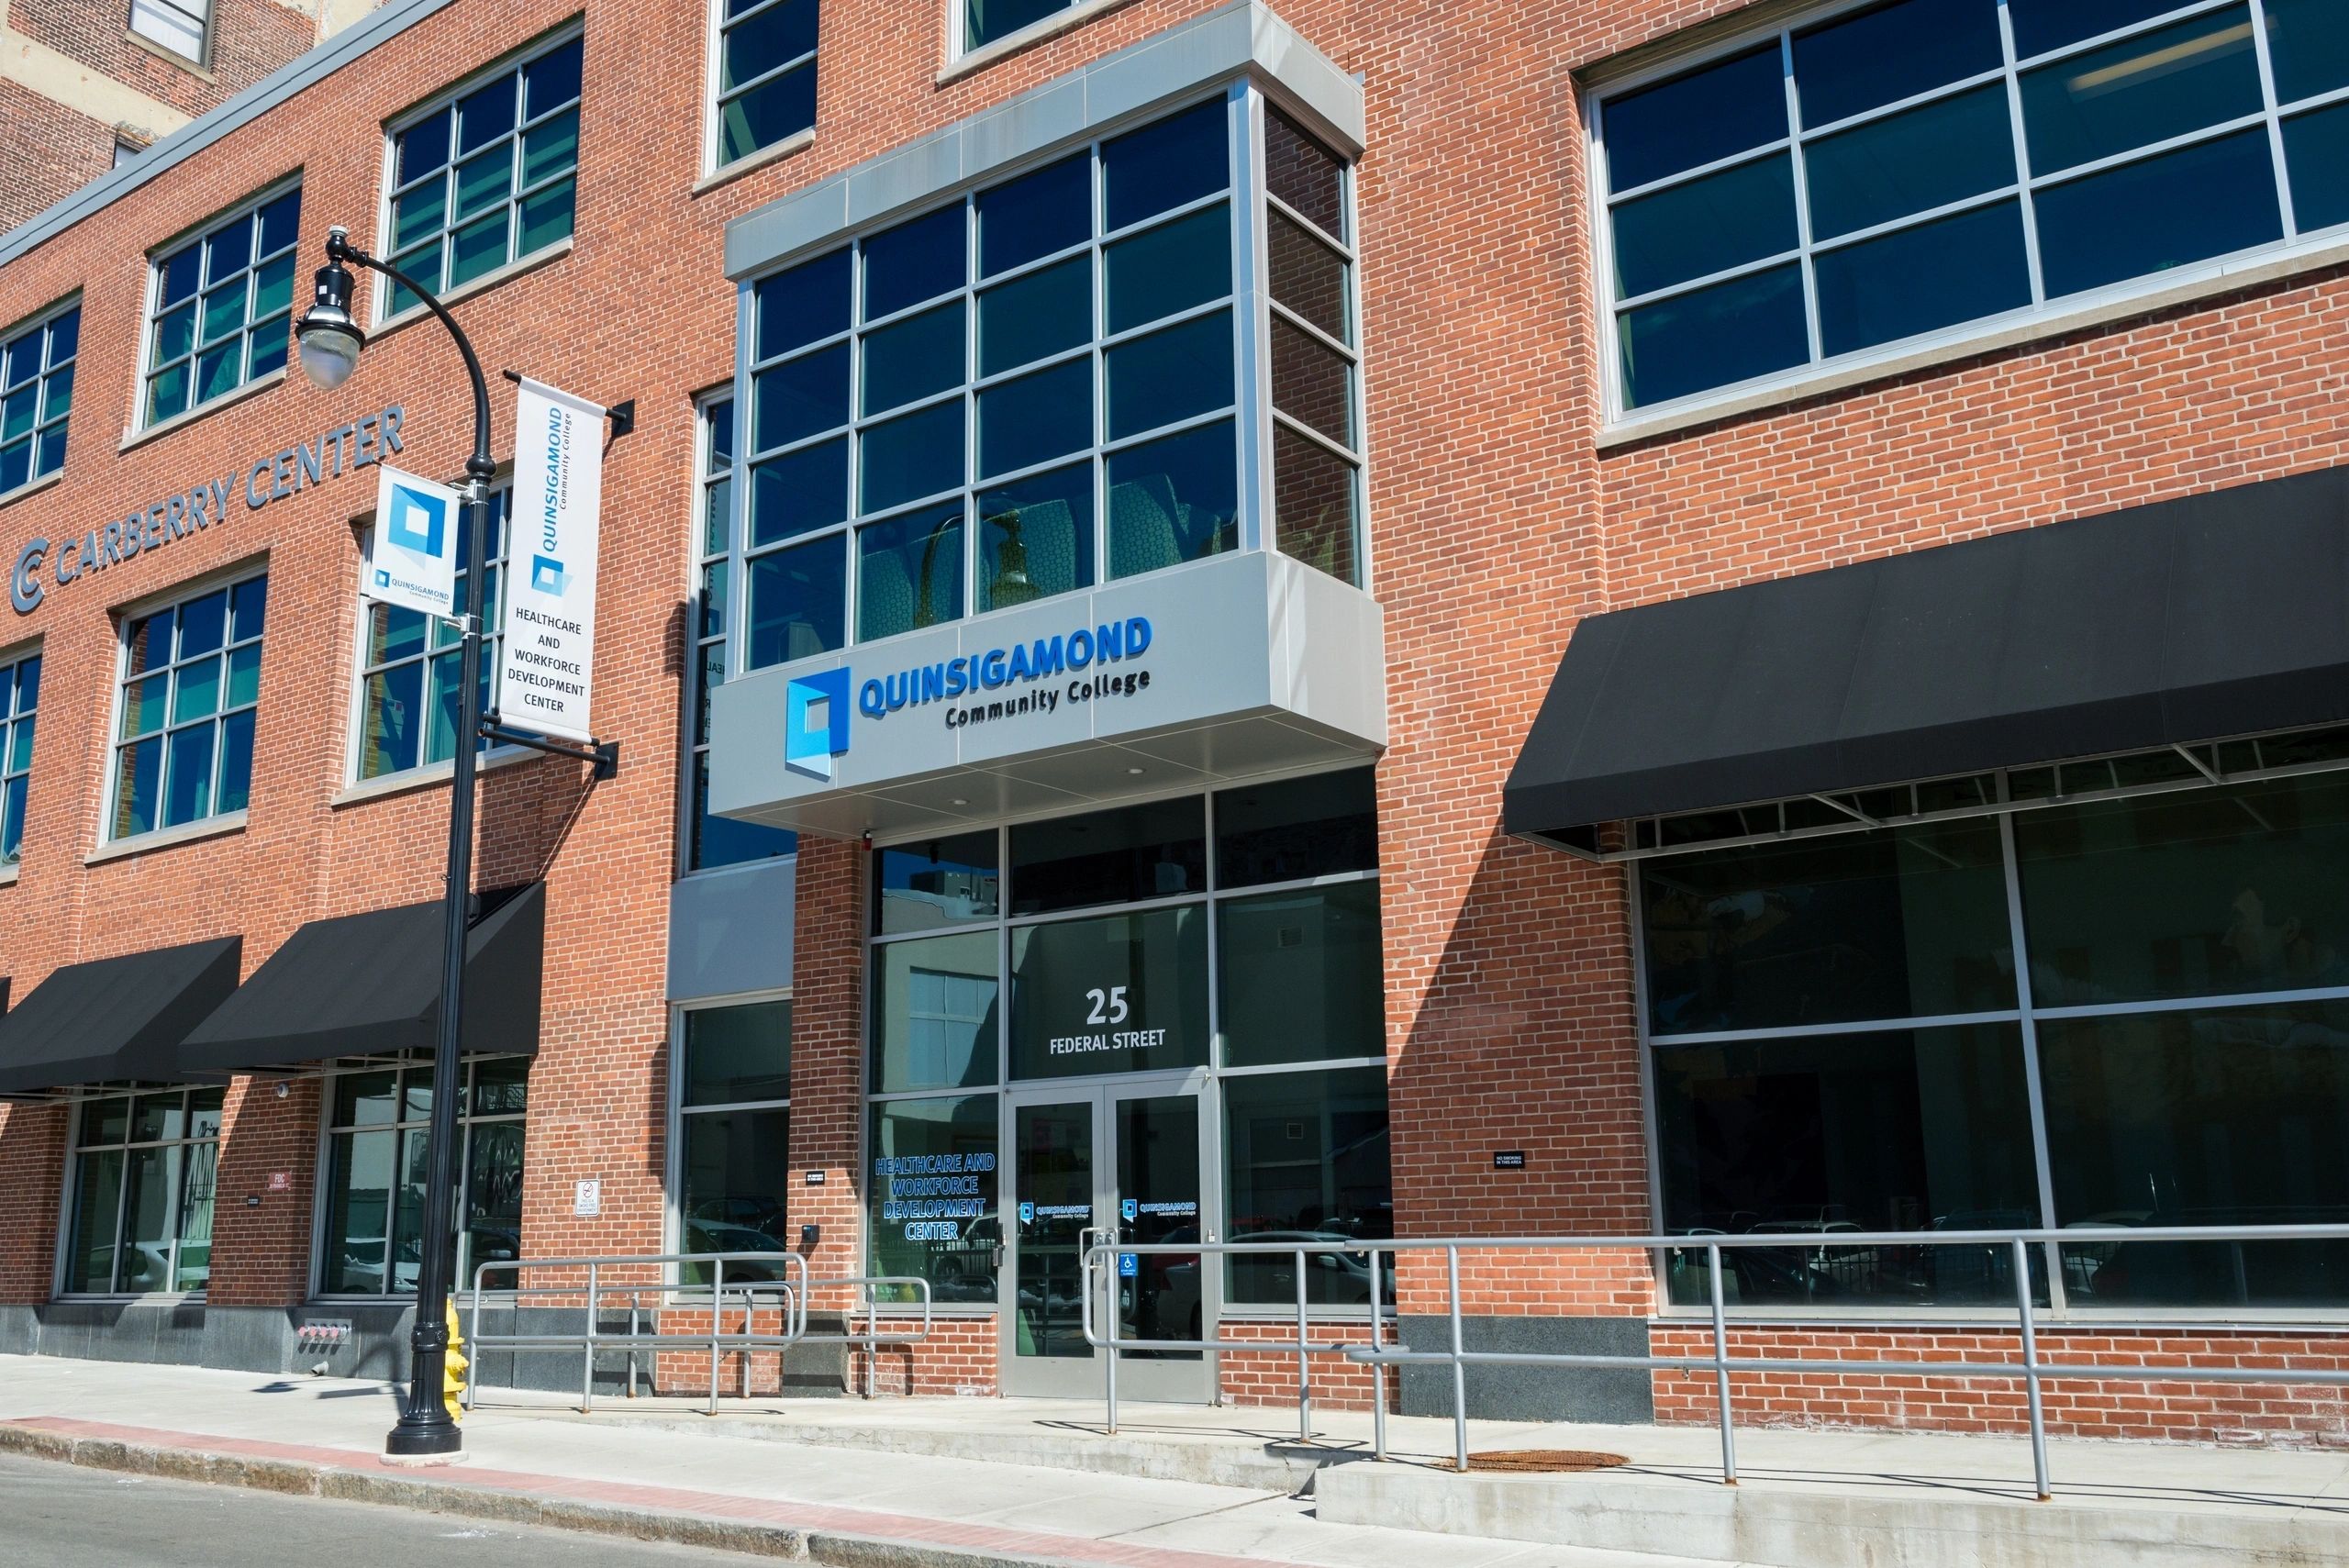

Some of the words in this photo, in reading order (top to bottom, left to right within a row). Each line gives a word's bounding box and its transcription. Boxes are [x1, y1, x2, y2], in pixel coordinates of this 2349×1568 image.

[562, 413, 573, 450] College
[542, 407, 562, 552] QUINSIGAMOND
[560, 453, 571, 510] Community
[56, 471, 238, 584] CARBERRY
[245, 404, 405, 509] CENTER
[391, 578, 450, 600] QUINSIGAMOND
[516, 606, 582, 635] HEALTHCARE
[538, 634, 561, 650] AND
[515, 648, 581, 675] WORKFORCE
[859, 616, 1152, 717] QUINSIGAMOND
[508, 668, 585, 696] DEVELOPMENT
[524, 693, 564, 713] CENTER
[945, 688, 1061, 729] Community
[1067, 669, 1152, 704] College
[1085, 985, 1129, 1025] 25
[1050, 1034, 1109, 1054] FEDERAL
[1112, 1029, 1166, 1050] STREET
[875, 1153, 963, 1175] HEALTHCARE
[963, 1152, 996, 1173] AND
[891, 1176, 979, 1196] WORKFORCE
[884, 1198, 986, 1219] DEVELOPMENT
[1036, 1205, 1089, 1216] QUINSIGAMOND
[1140, 1202, 1197, 1213] QUINSIGAMOND
[905, 1221, 959, 1240] CENTER
